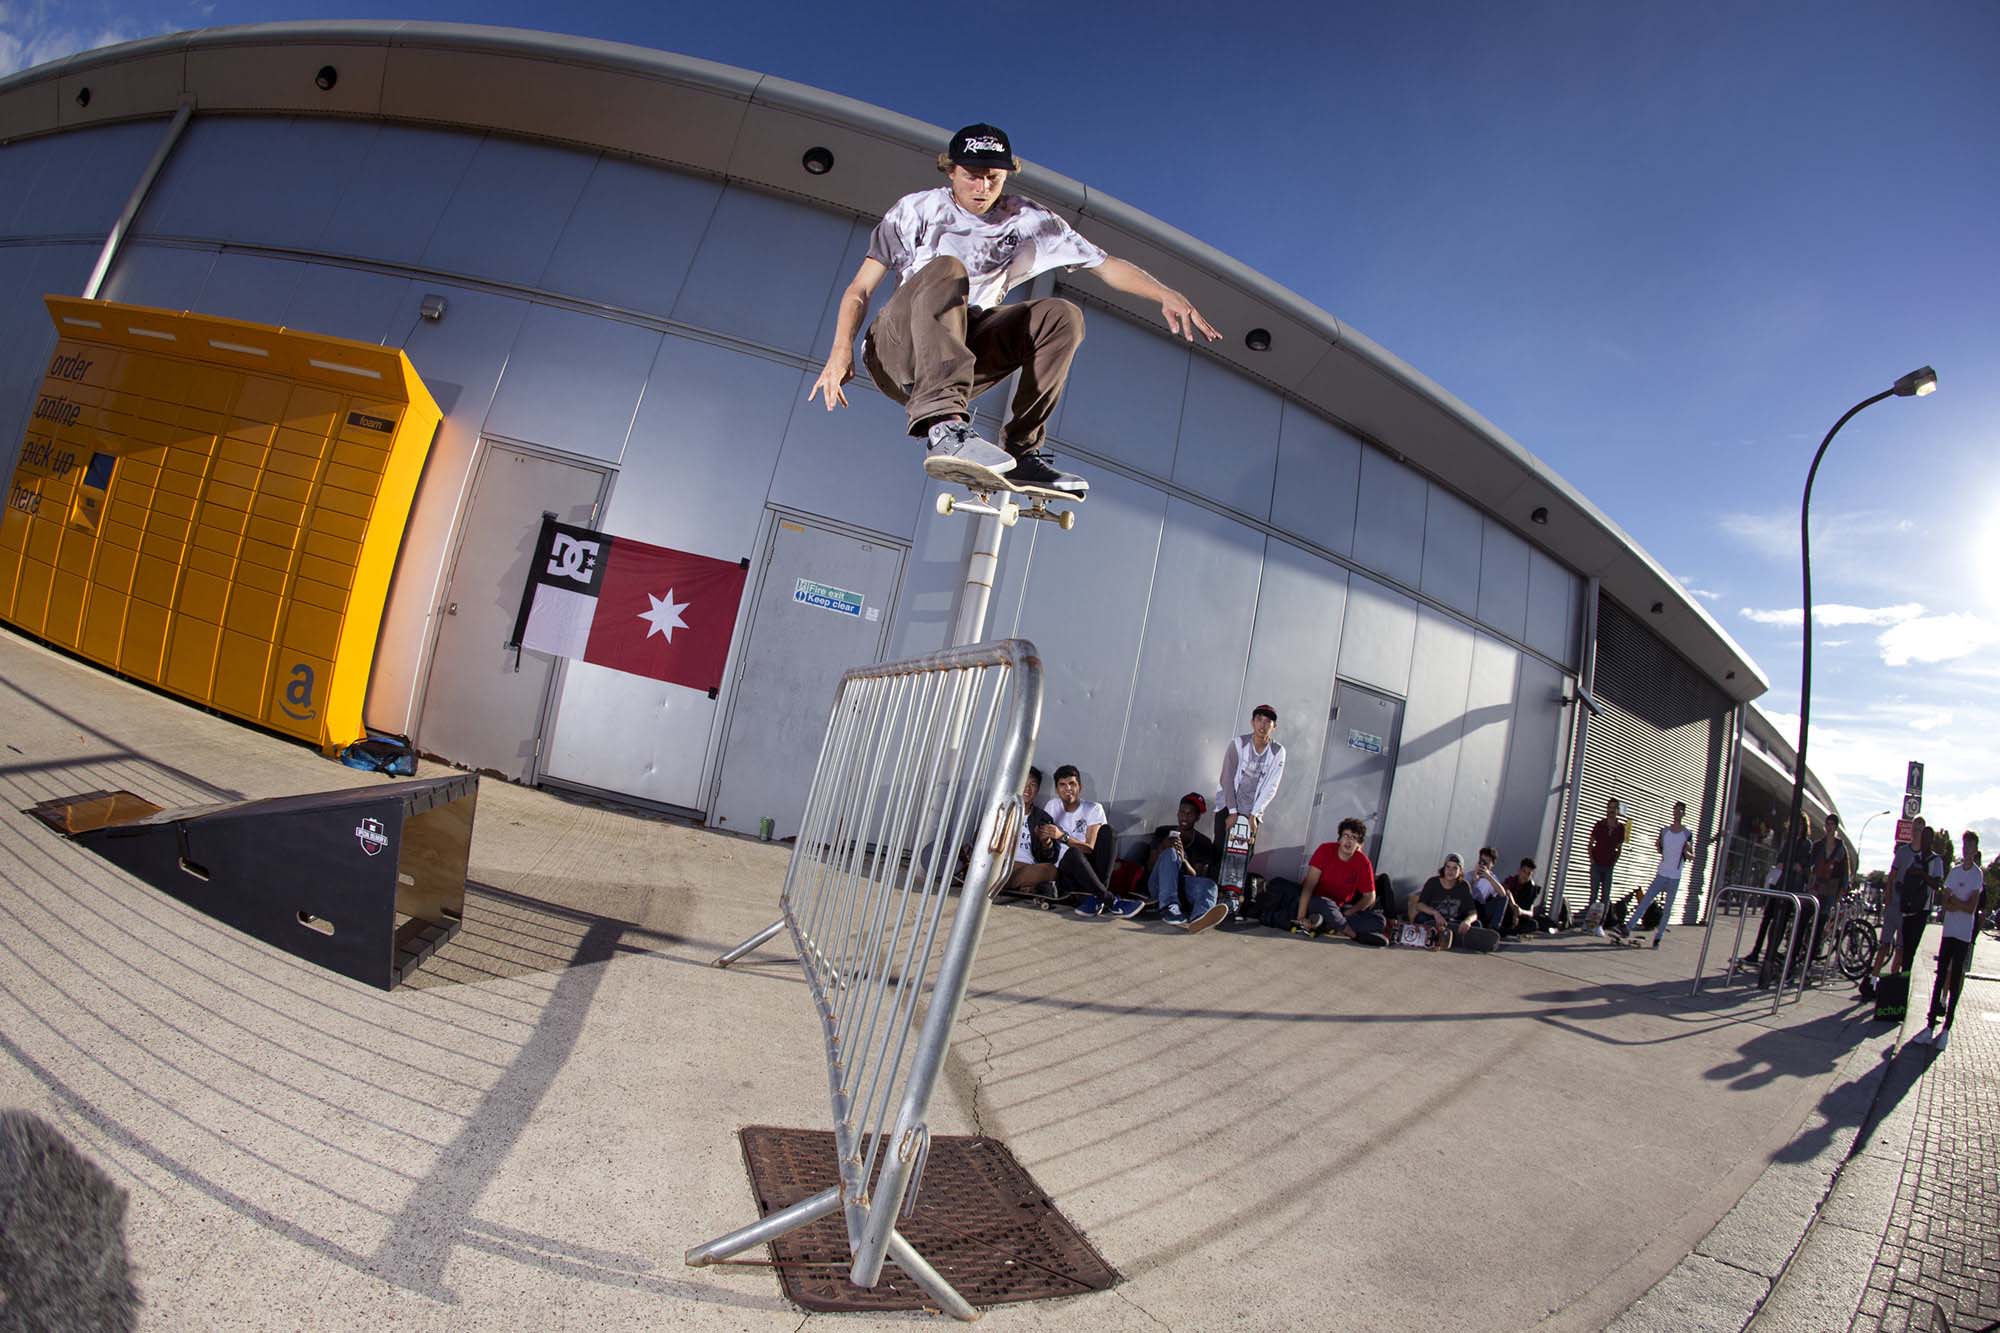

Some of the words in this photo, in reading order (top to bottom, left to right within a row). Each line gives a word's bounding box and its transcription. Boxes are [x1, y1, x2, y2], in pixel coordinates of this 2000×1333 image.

[50, 352, 93, 381] order
[37, 397, 81, 427] online
[21, 439, 53, 468] pick
[53, 450, 75, 480] up
[10, 480, 42, 513] here
[547, 532, 600, 584] DC
[807, 592, 831, 608] Keep
[832, 600, 856, 613] clear
[809, 584, 826, 595] Fire
[828, 590, 846, 600] exit
